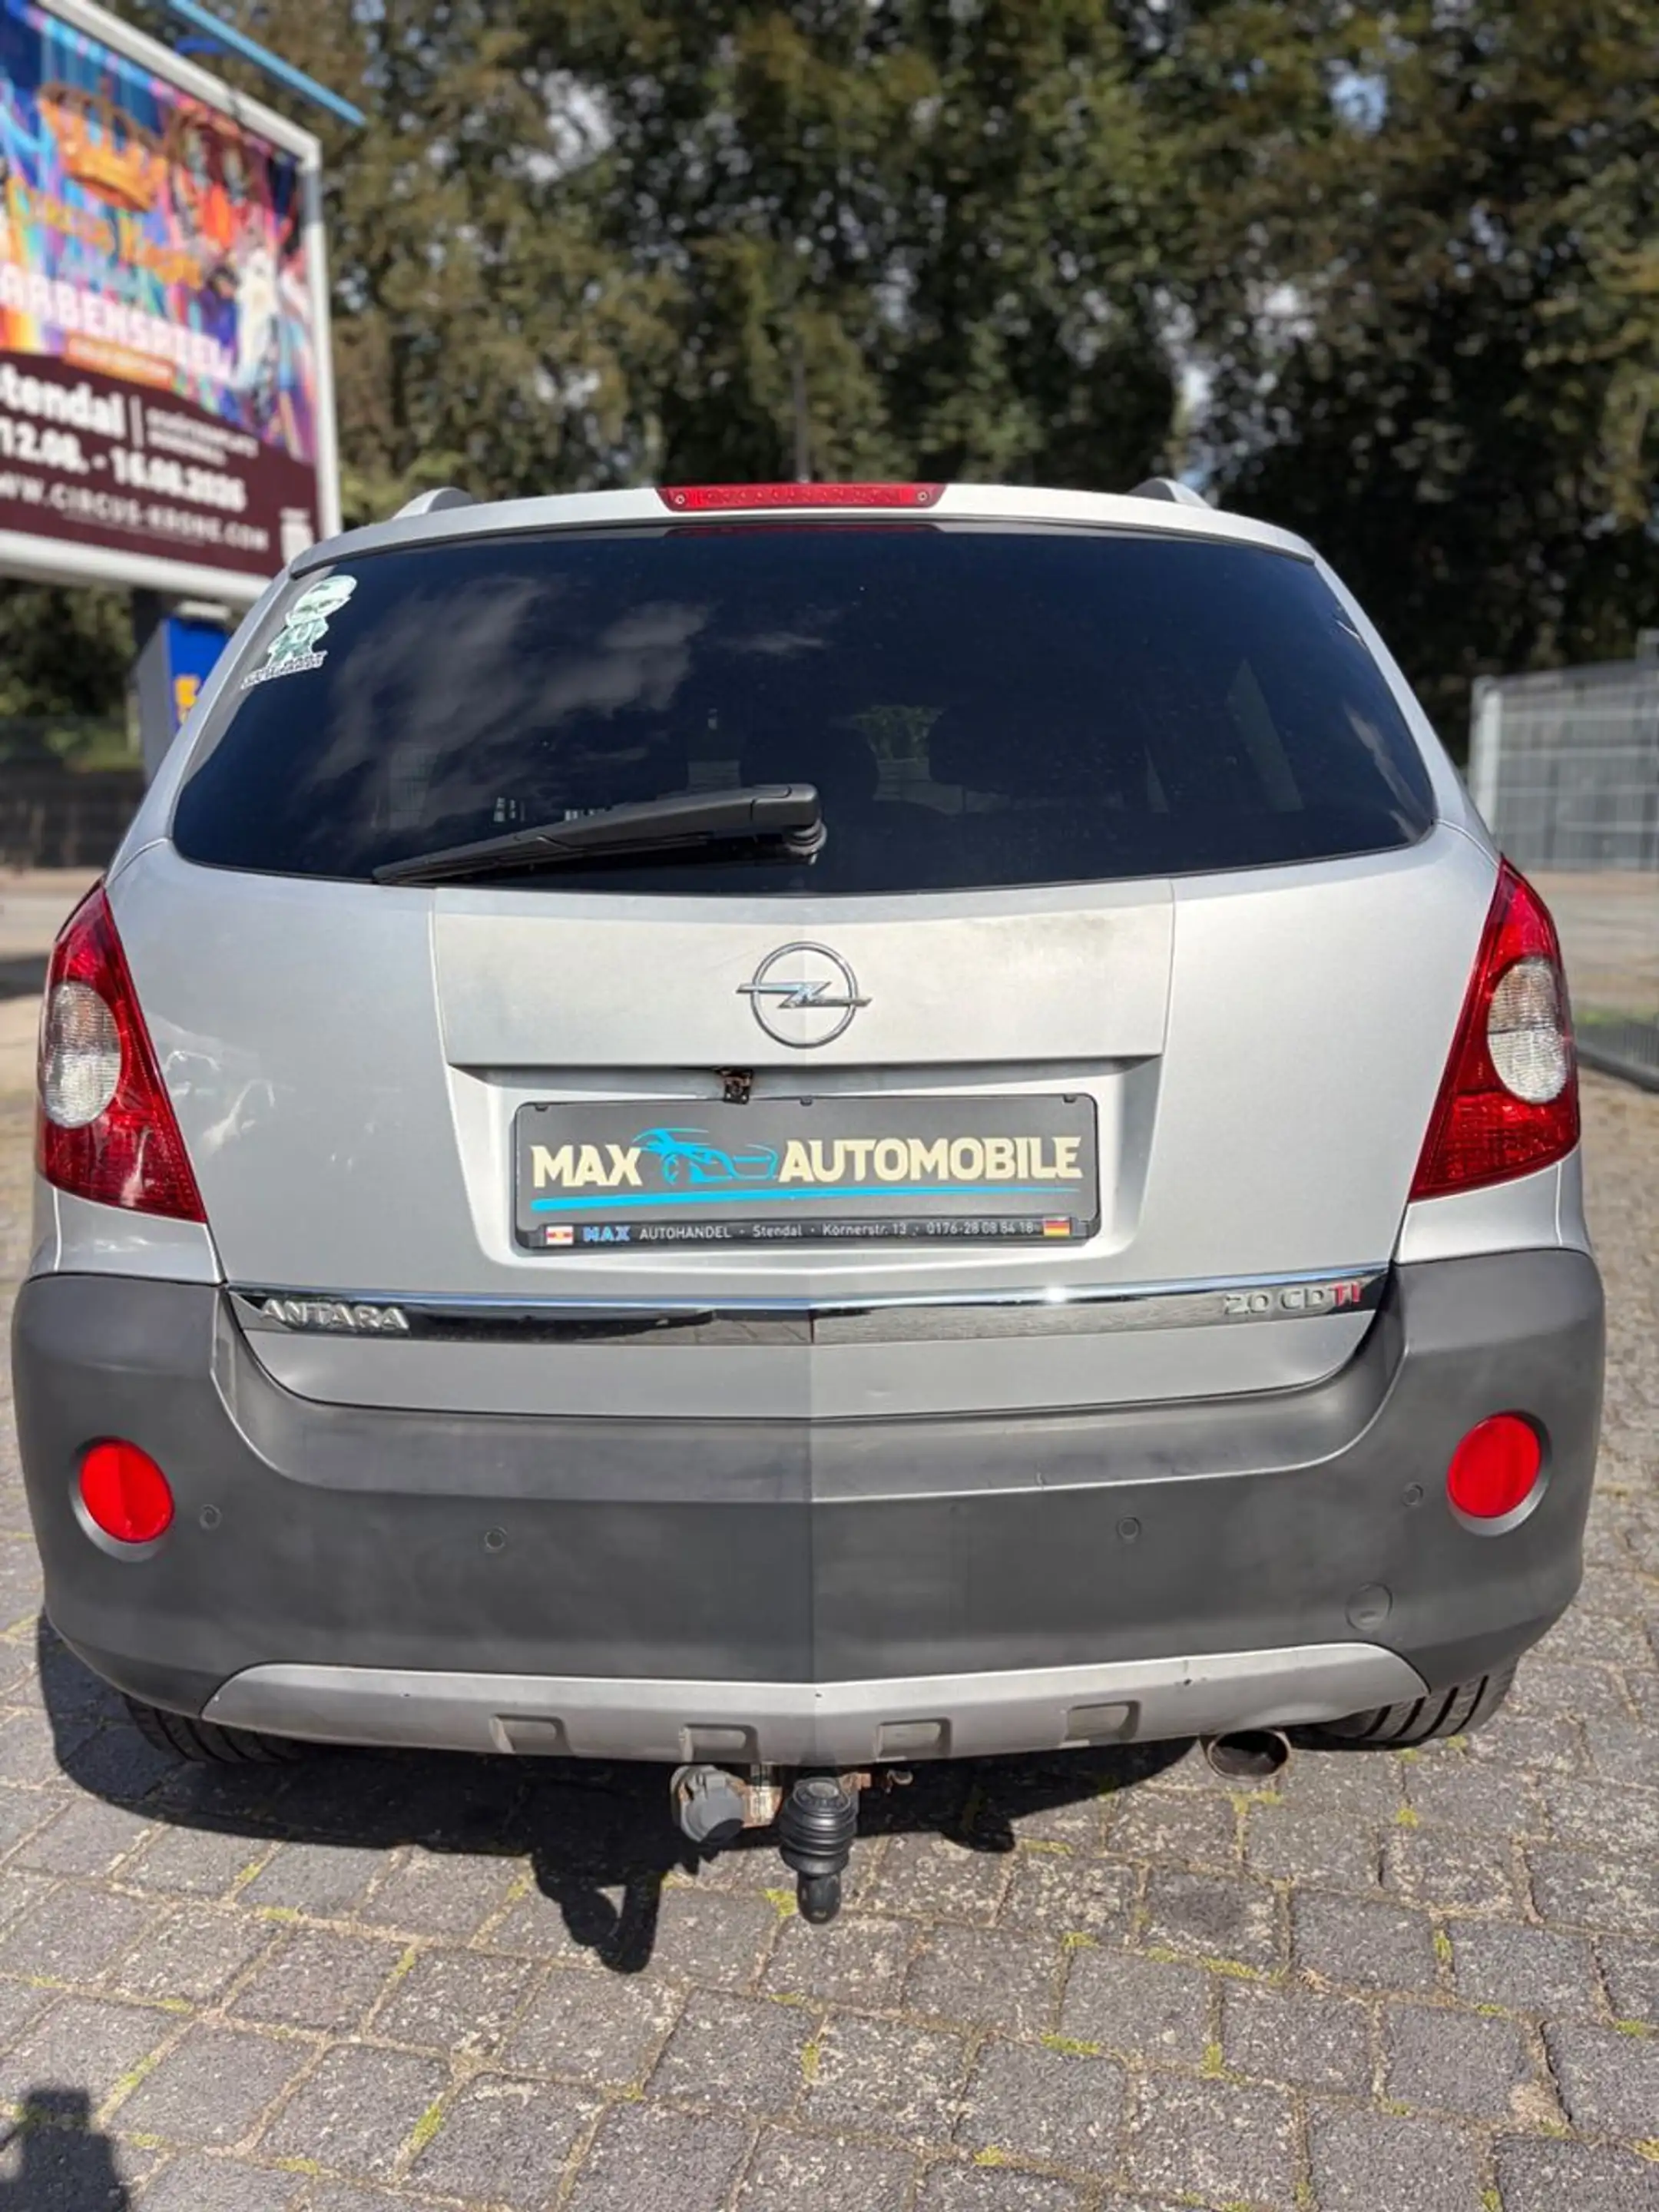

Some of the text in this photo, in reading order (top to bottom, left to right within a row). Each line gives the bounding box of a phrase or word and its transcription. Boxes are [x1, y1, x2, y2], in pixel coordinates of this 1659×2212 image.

[0, 361, 125, 440] tendal
[530, 1136, 1084, 1187] MAX AUTOMOBILE
[582, 1225, 631, 1242] MAX
[639, 1225, 732, 1240] AUTOHANDEL
[753, 1224, 802, 1239] Stendal
[1280, 1280, 1363, 1310] CDTI
[261, 1298, 410, 1330] ANTARA
